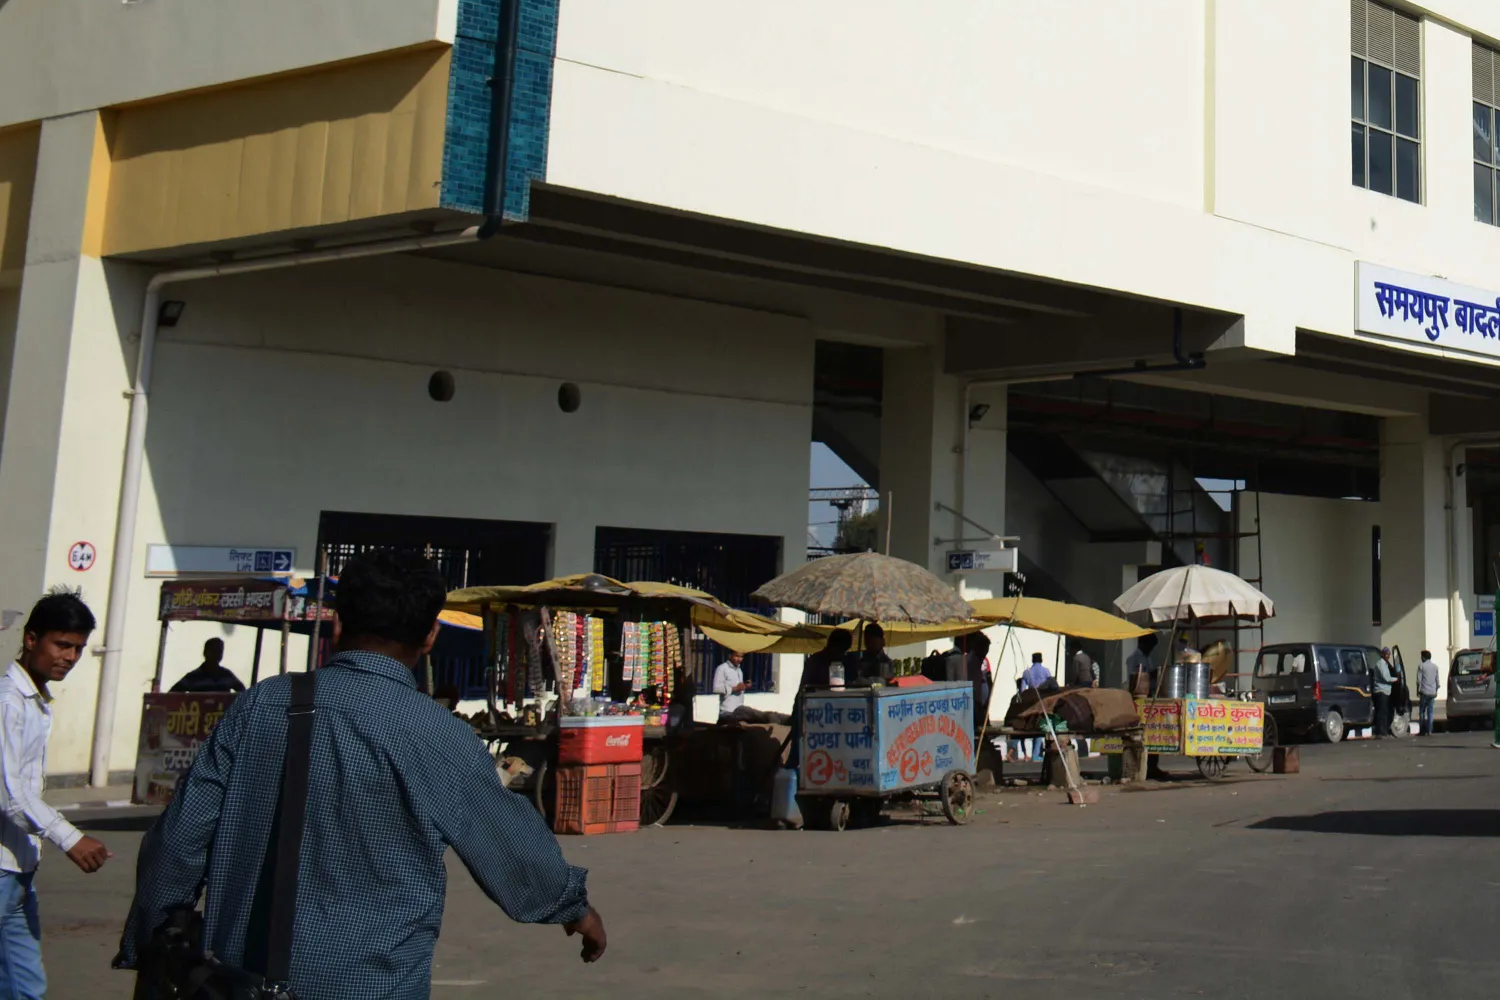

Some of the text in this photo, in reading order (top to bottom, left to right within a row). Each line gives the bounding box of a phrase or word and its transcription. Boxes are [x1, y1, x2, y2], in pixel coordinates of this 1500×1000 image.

[1374, 281, 1450, 341] समयपुर
[237, 563, 252, 572] Lift
[167, 701, 201, 736] गौरी
[806, 702, 869, 728] मशीन का
[888, 699, 913, 722] मशीन
[915, 701, 927, 715] का
[952, 693, 970, 710] पानी
[1196, 703, 1262, 722] छोले कुल्चे
[808, 725, 873, 750] ठण्डा पानी
